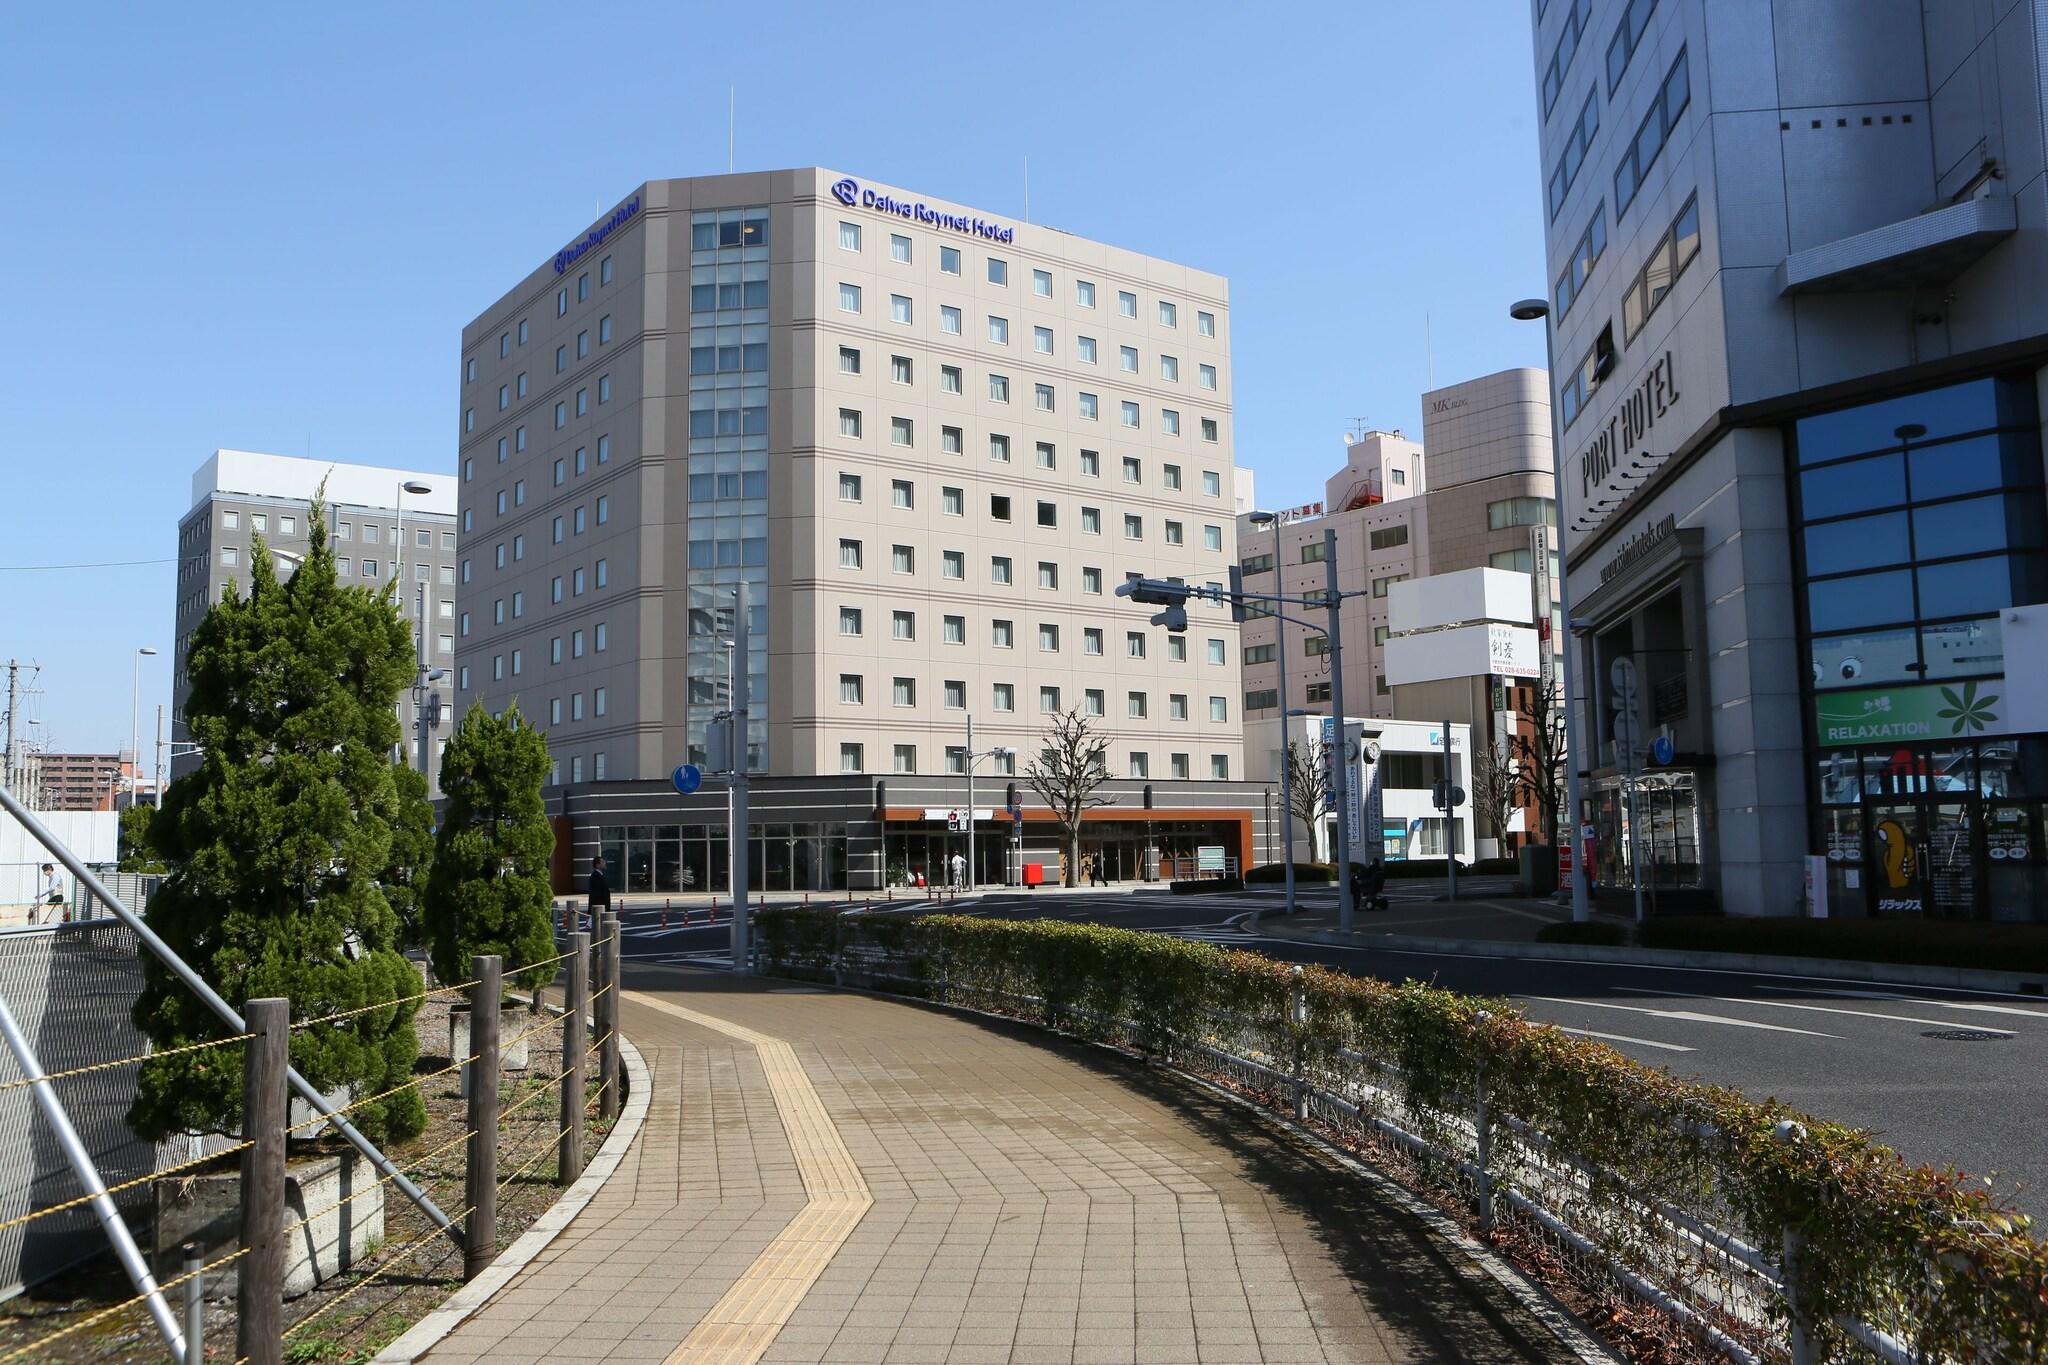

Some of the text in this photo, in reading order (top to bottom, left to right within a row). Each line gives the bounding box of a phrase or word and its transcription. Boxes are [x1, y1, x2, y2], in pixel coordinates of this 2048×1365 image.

[863, 189, 1014, 244] Daiwa Roynet Hotel
[1582, 351, 1680, 498] PORT HOTEL
[1493, 665, 1504, 673] TEL
[1828, 721, 1931, 741] RELAXATION
[1879, 898, 1923, 911] リラックス
